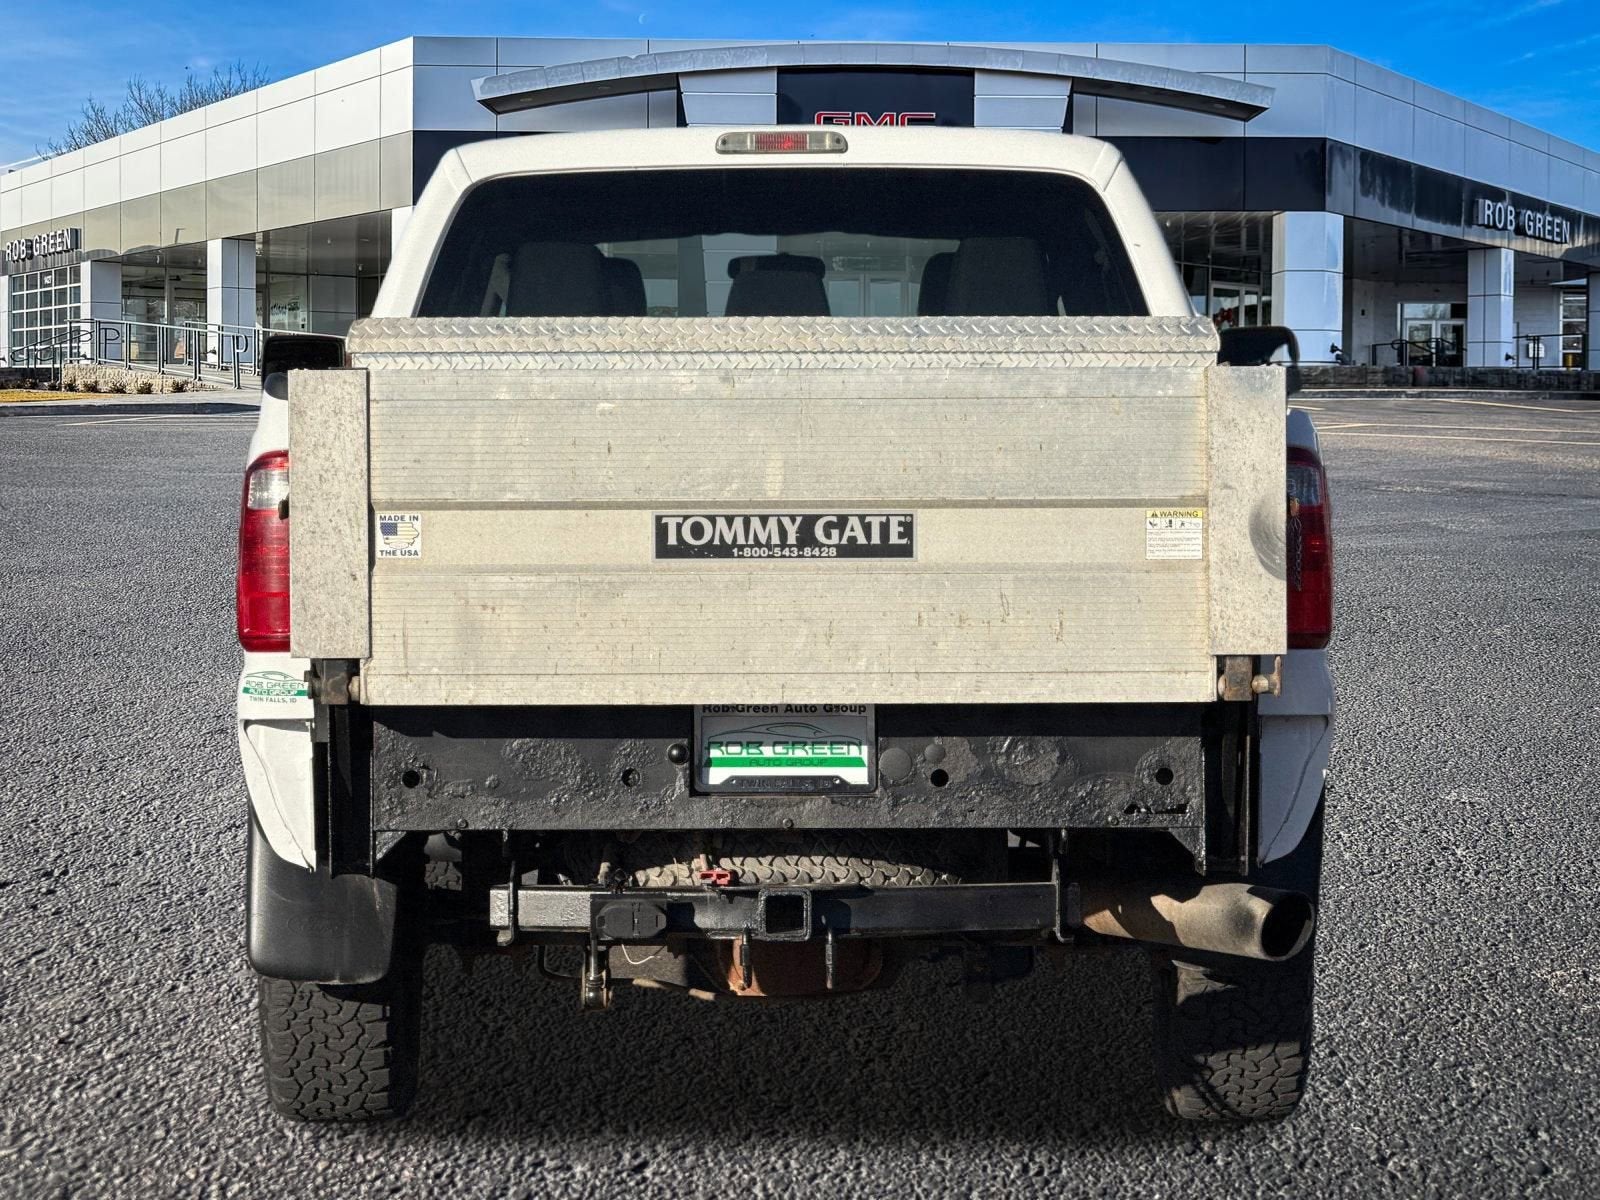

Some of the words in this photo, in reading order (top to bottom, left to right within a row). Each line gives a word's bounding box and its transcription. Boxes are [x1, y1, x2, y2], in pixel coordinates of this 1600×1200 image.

[1484, 199, 1515, 231] ROB
[1525, 210, 1570, 243] GREEN
[6, 239, 27, 261] ROB
[33, 228, 71, 256] GREEN
[1160, 510, 1199, 518] WARNING
[662, 516, 803, 546] TOMMY
[814, 515, 909, 545] GATE
[732, 547, 837, 558] 1-800-543-8428
[735, 704, 779, 713] Green
[784, 704, 818, 713] Auto
[707, 740, 765, 756] ROB
[772, 740, 862, 756] GREEN
[749, 758, 782, 767] AUTO
